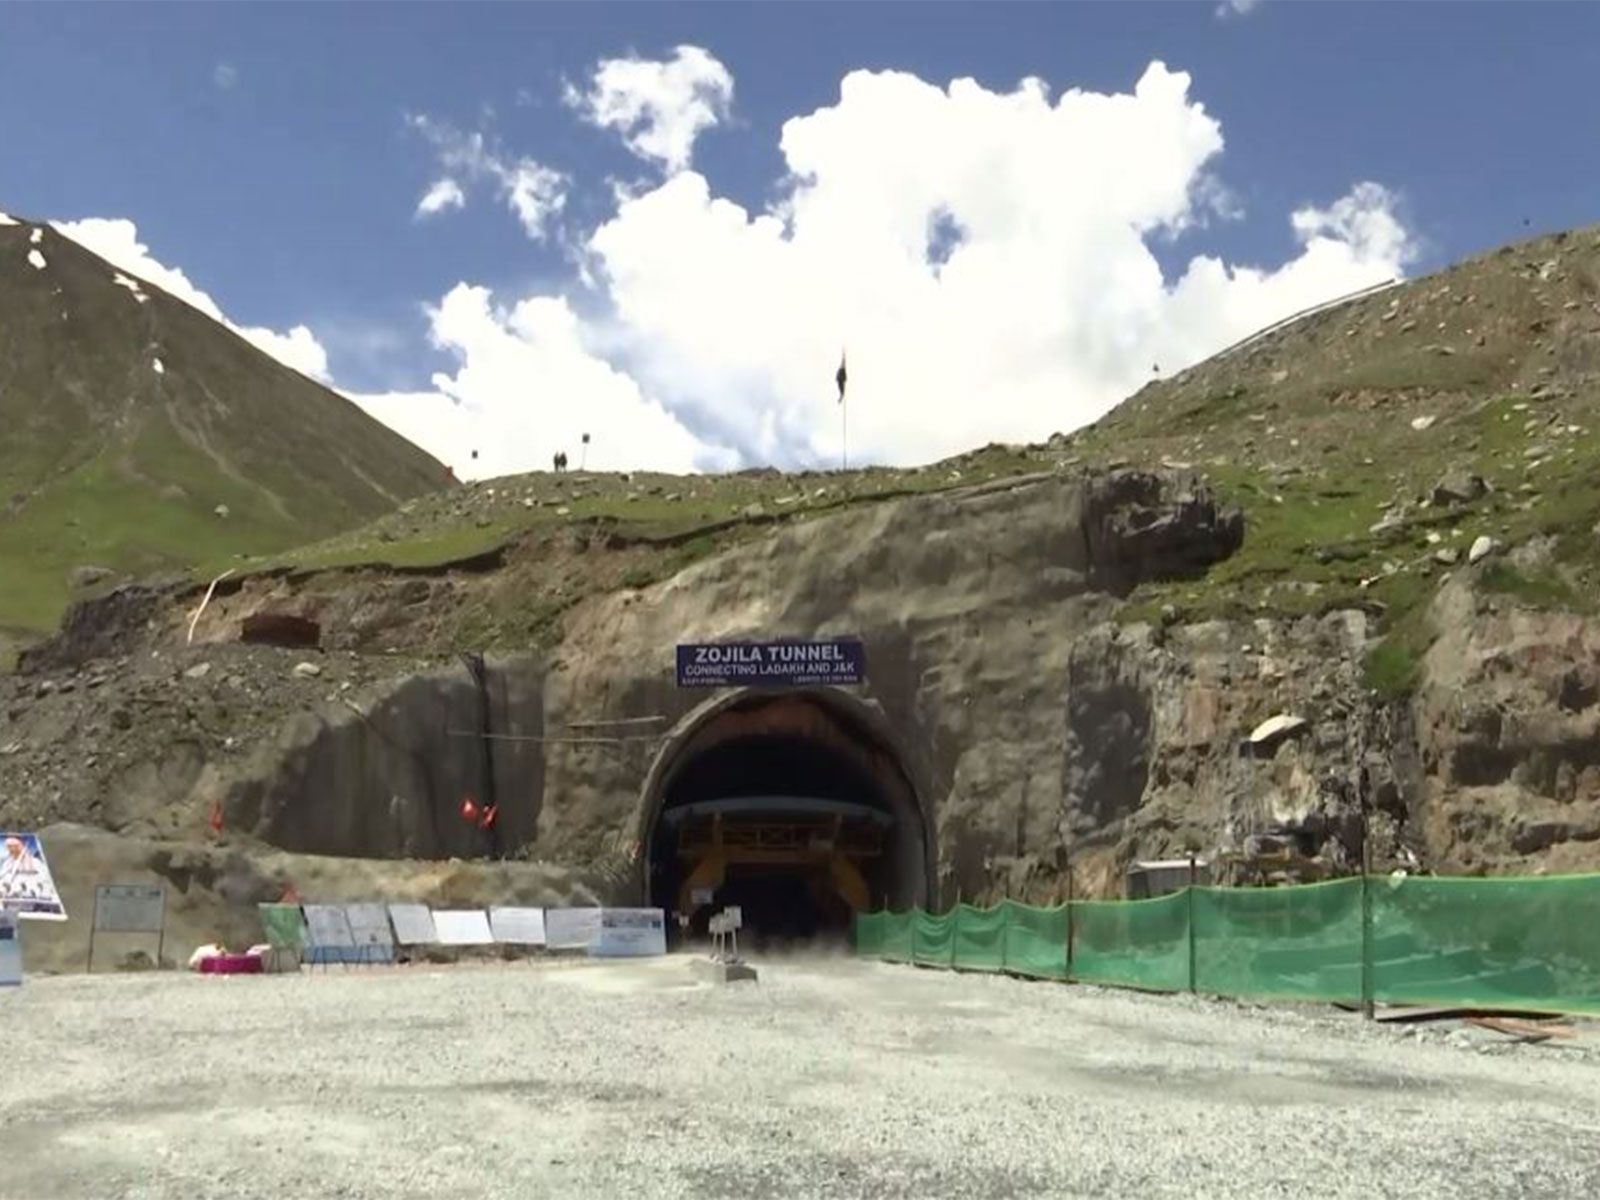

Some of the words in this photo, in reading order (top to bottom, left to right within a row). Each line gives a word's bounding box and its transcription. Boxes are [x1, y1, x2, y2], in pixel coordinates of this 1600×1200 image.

[695, 647, 762, 663] ZOJILA
[767, 645, 844, 661] TUNNEL
[685, 664, 757, 676] CONNECTING
[759, 662, 805, 675] LADAKH
[807, 662, 831, 674] AND
[833, 662, 855, 673] J&K
